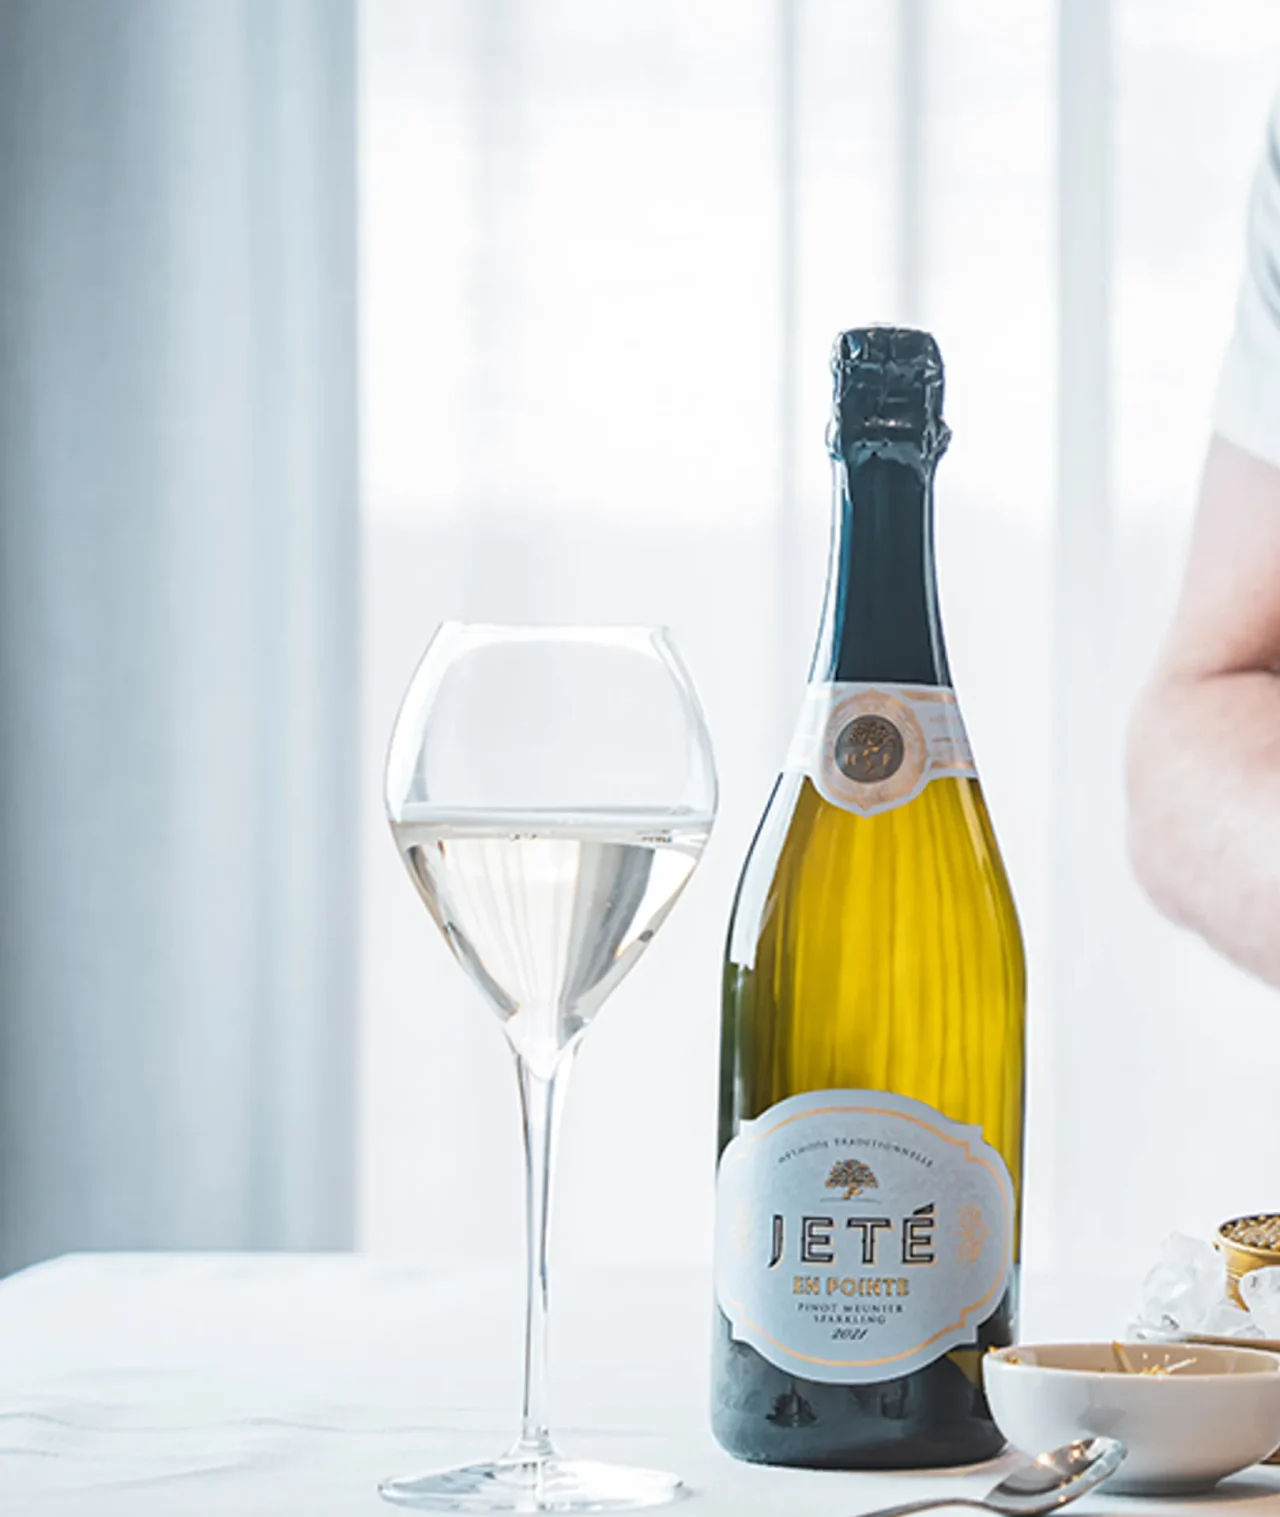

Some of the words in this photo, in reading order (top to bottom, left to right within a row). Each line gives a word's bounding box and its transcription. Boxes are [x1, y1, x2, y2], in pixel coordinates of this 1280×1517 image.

[768, 1202, 938, 1269] JETÉ
[793, 1276, 819, 1295] EN
[826, 1277, 910, 1296] POINTE
[798, 1302, 837, 1313] PINOT
[843, 1303, 903, 1314] MEUNIER
[813, 1314, 886, 1325] SPARKLING
